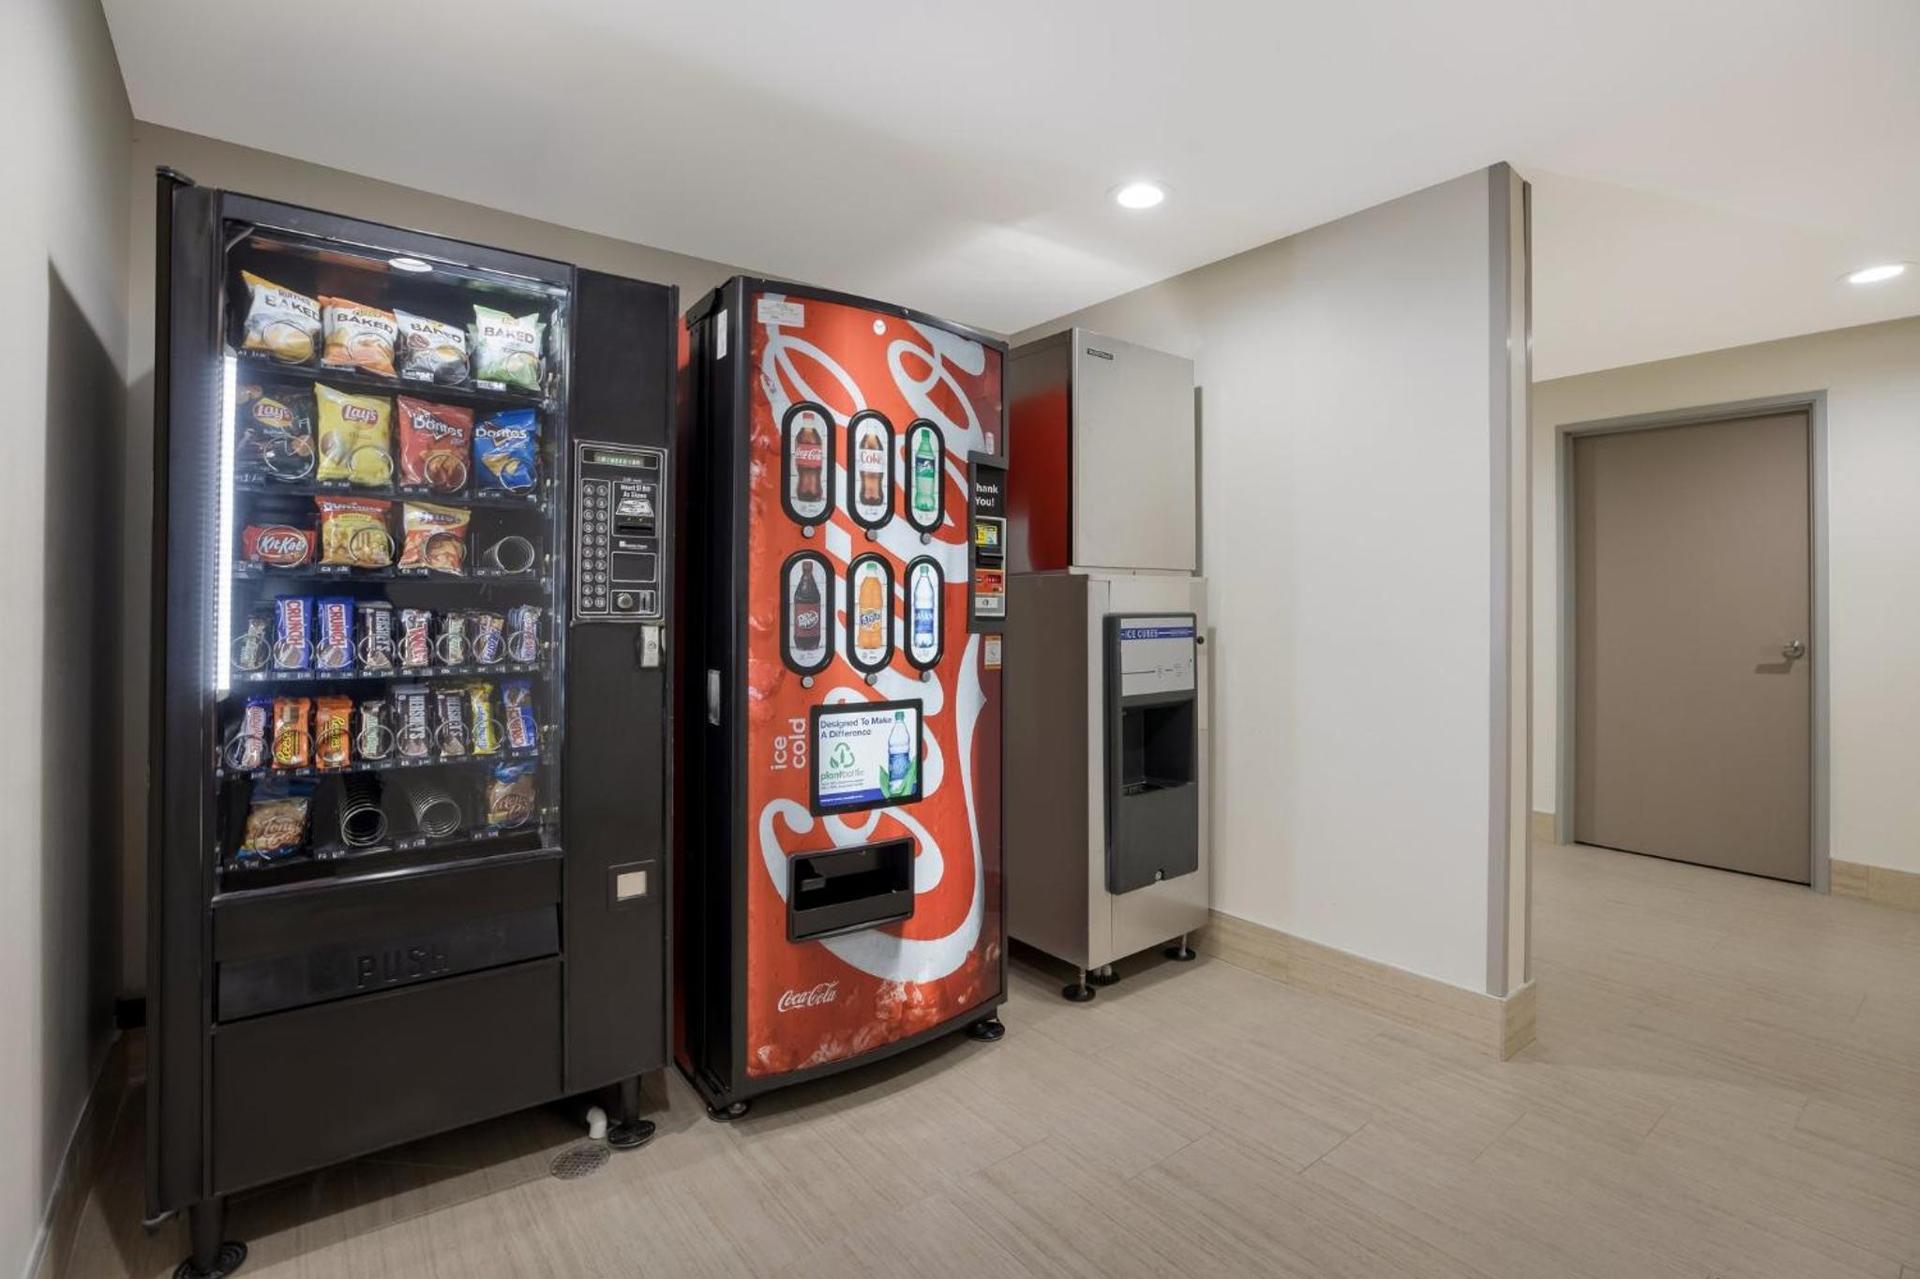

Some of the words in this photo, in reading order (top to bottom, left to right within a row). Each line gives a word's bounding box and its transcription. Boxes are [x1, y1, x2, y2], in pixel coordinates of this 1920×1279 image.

[337, 313, 394, 335] BAKED
[484, 327, 534, 344] BAKED
[344, 404, 377, 422] Lay's
[976, 483, 998, 494] hank
[287, 601, 303, 645] CRUNCH
[329, 605, 345, 645] CRUNCH
[821, 719, 859, 729] Designed
[861, 717, 870, 725] To
[871, 716, 892, 725] Make
[821, 730, 827, 738] A
[829, 729, 871, 738] Difference
[771, 726, 788, 770] ice
[789, 718, 806, 769] cold
[778, 980, 839, 1012] Coca-Cola
